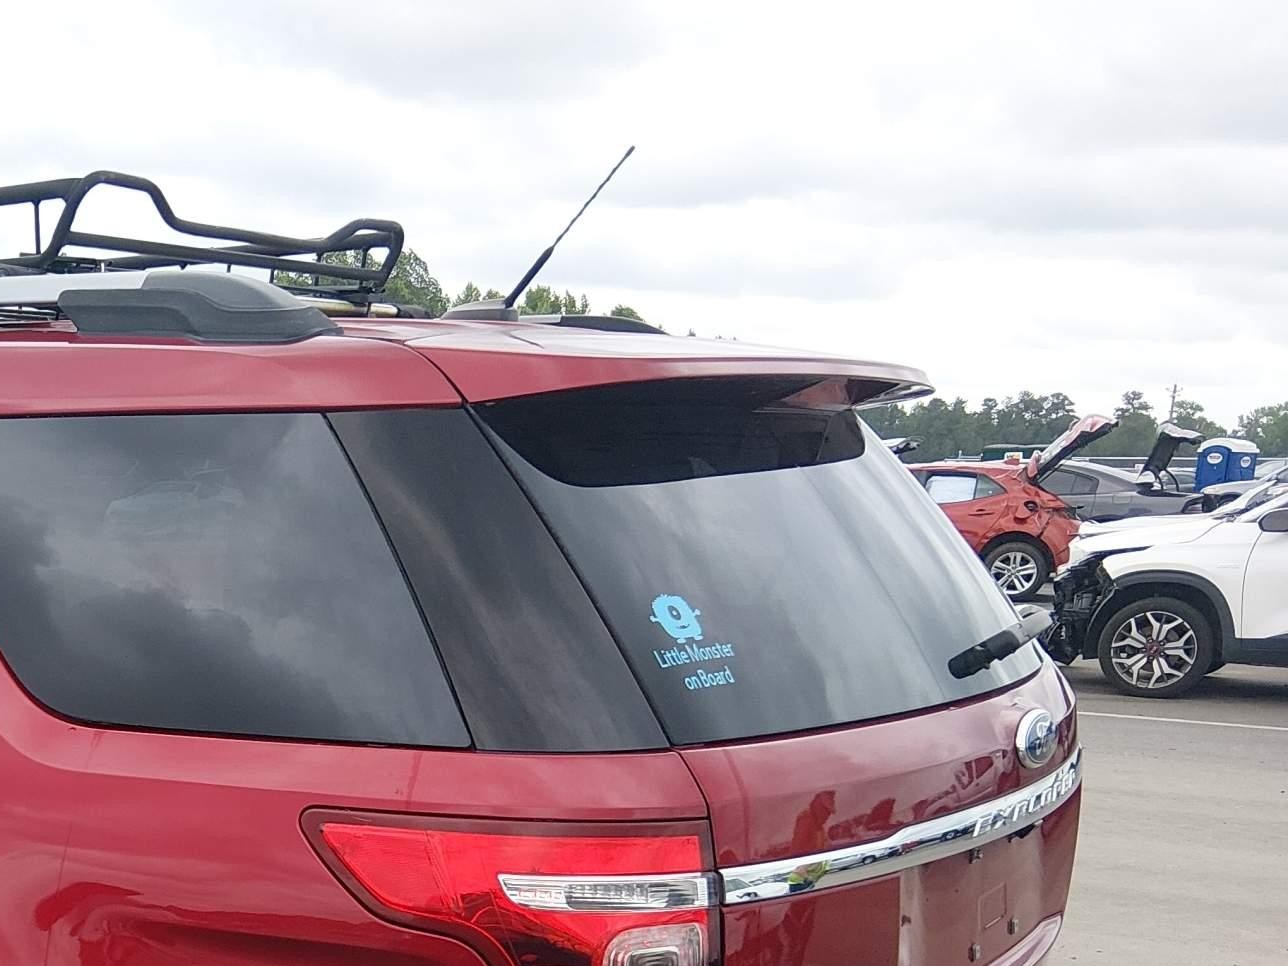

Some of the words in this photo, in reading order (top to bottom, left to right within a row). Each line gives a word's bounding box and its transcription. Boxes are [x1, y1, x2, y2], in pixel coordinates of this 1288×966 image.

[653, 646, 690, 668] Little
[685, 642, 735, 662] Monster
[684, 676, 700, 690] on
[697, 666, 735, 688] Board
